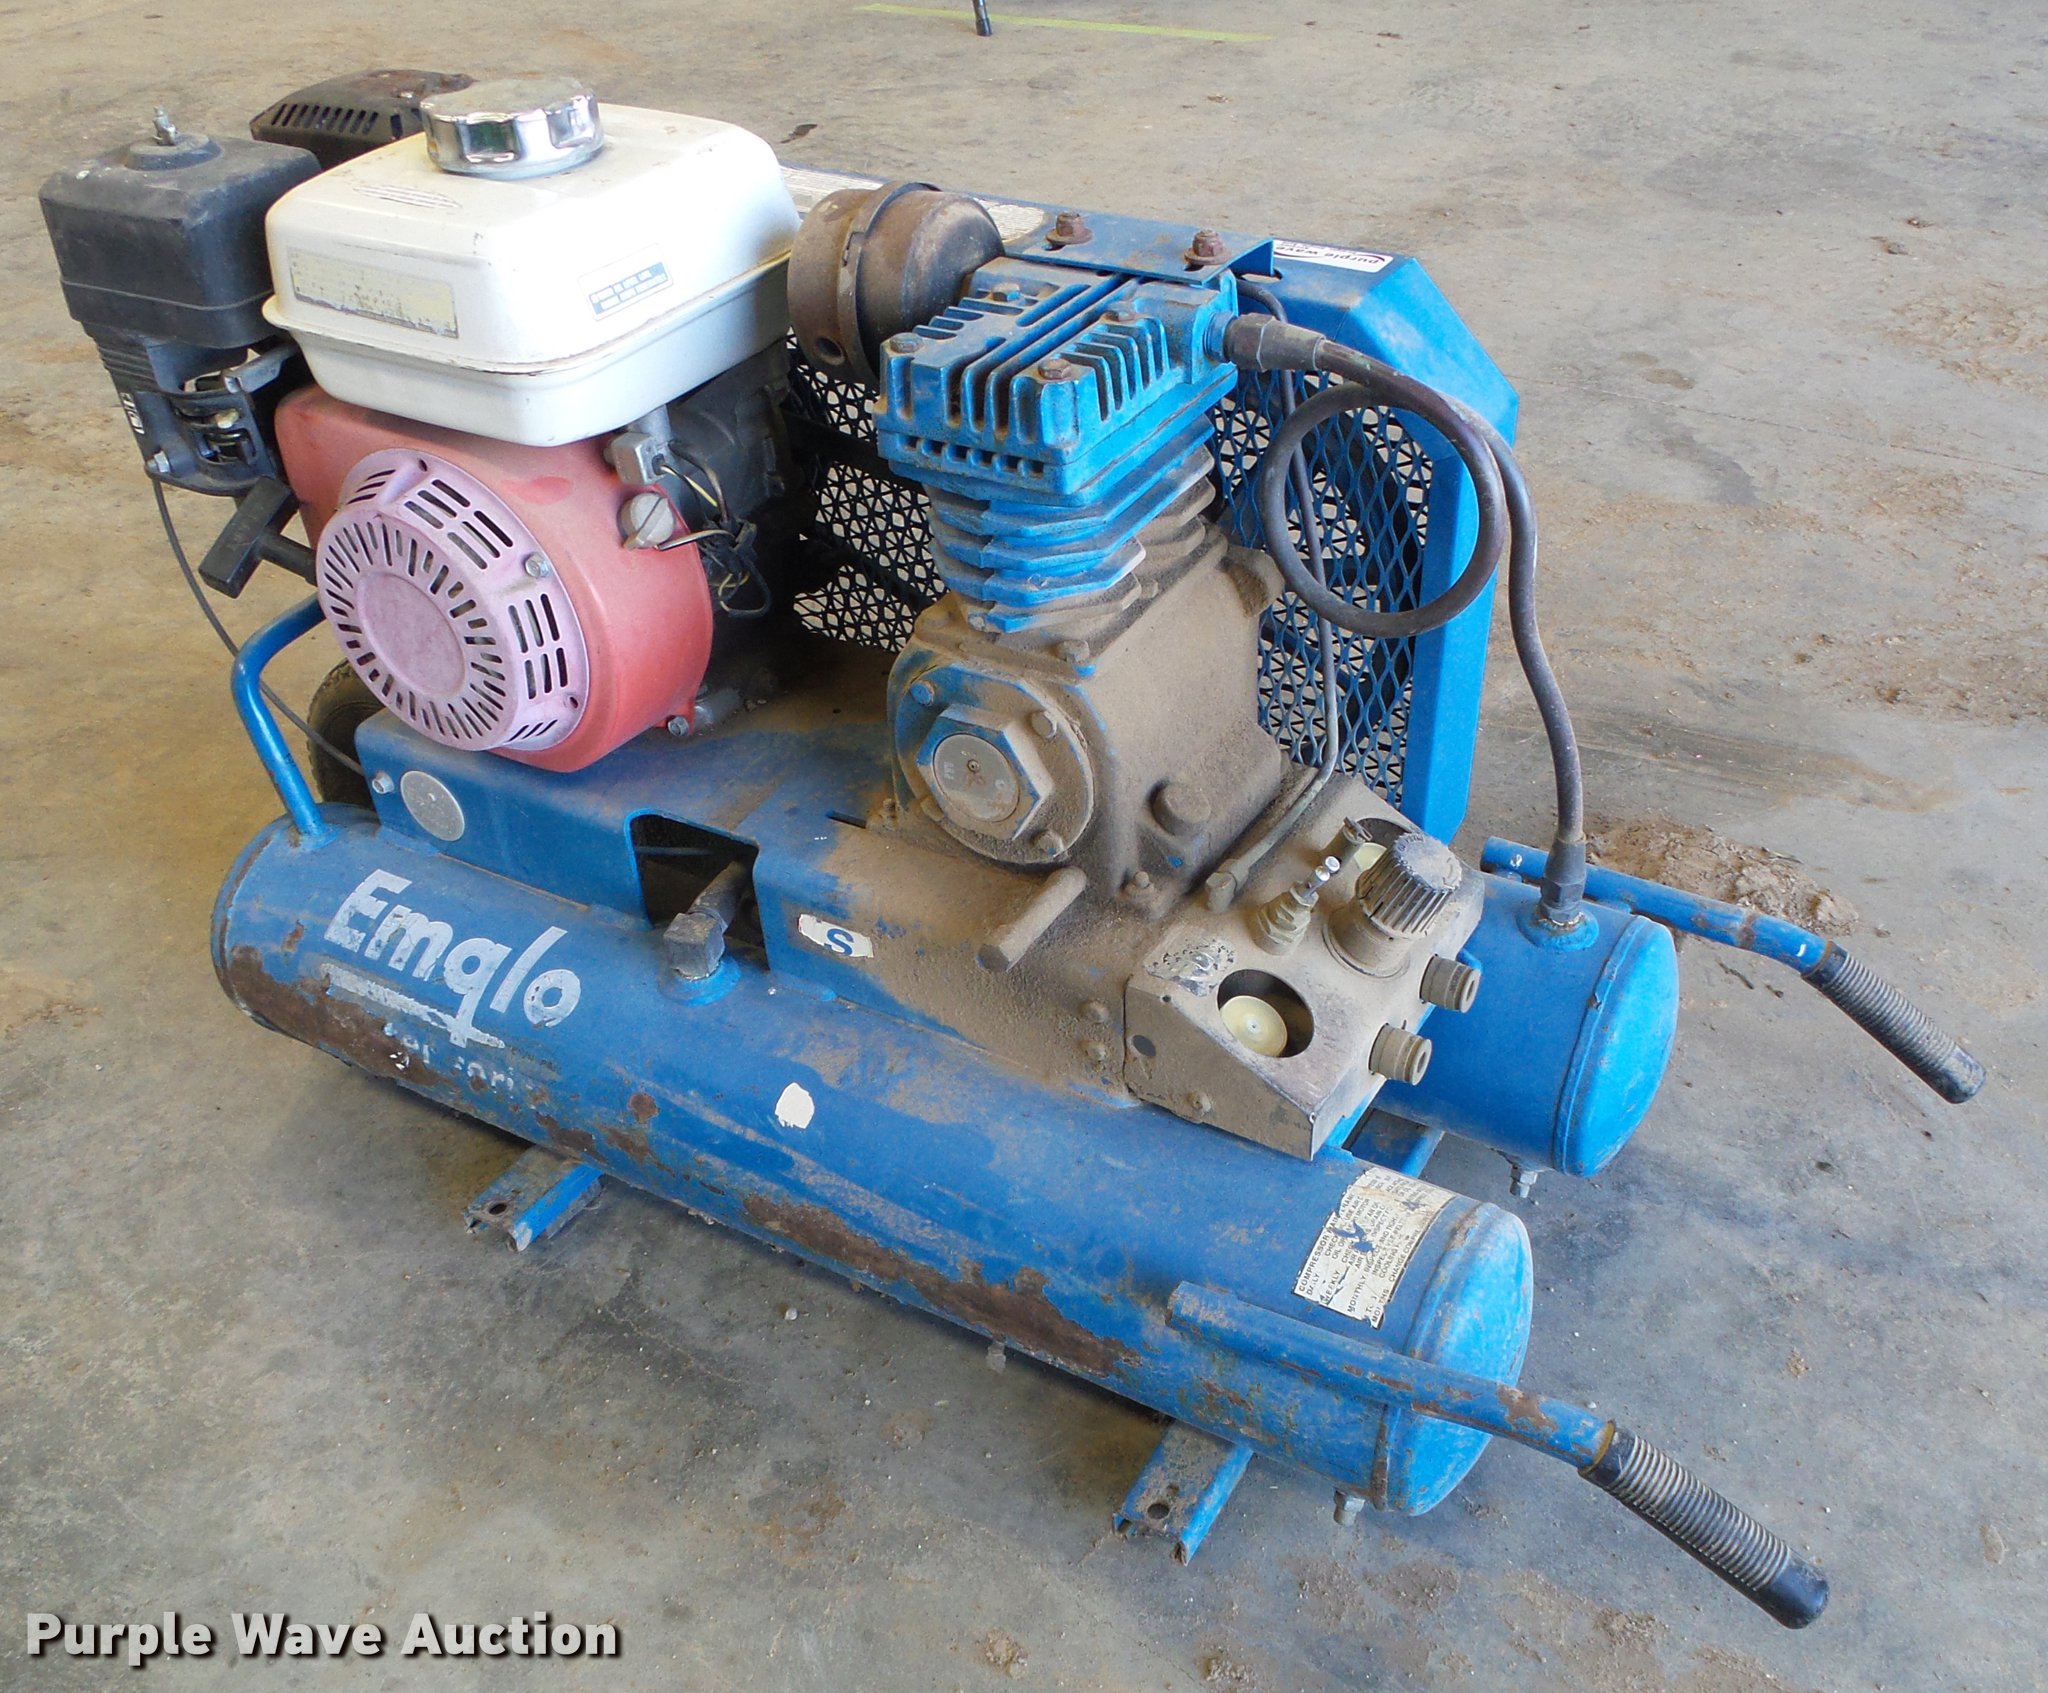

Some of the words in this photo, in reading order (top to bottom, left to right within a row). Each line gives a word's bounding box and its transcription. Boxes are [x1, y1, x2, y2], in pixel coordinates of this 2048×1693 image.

[1275, 246, 1318, 255] wave
[1324, 252, 1379, 264] purple
[1298, 1234, 1329, 1292] COMPRESSOR
